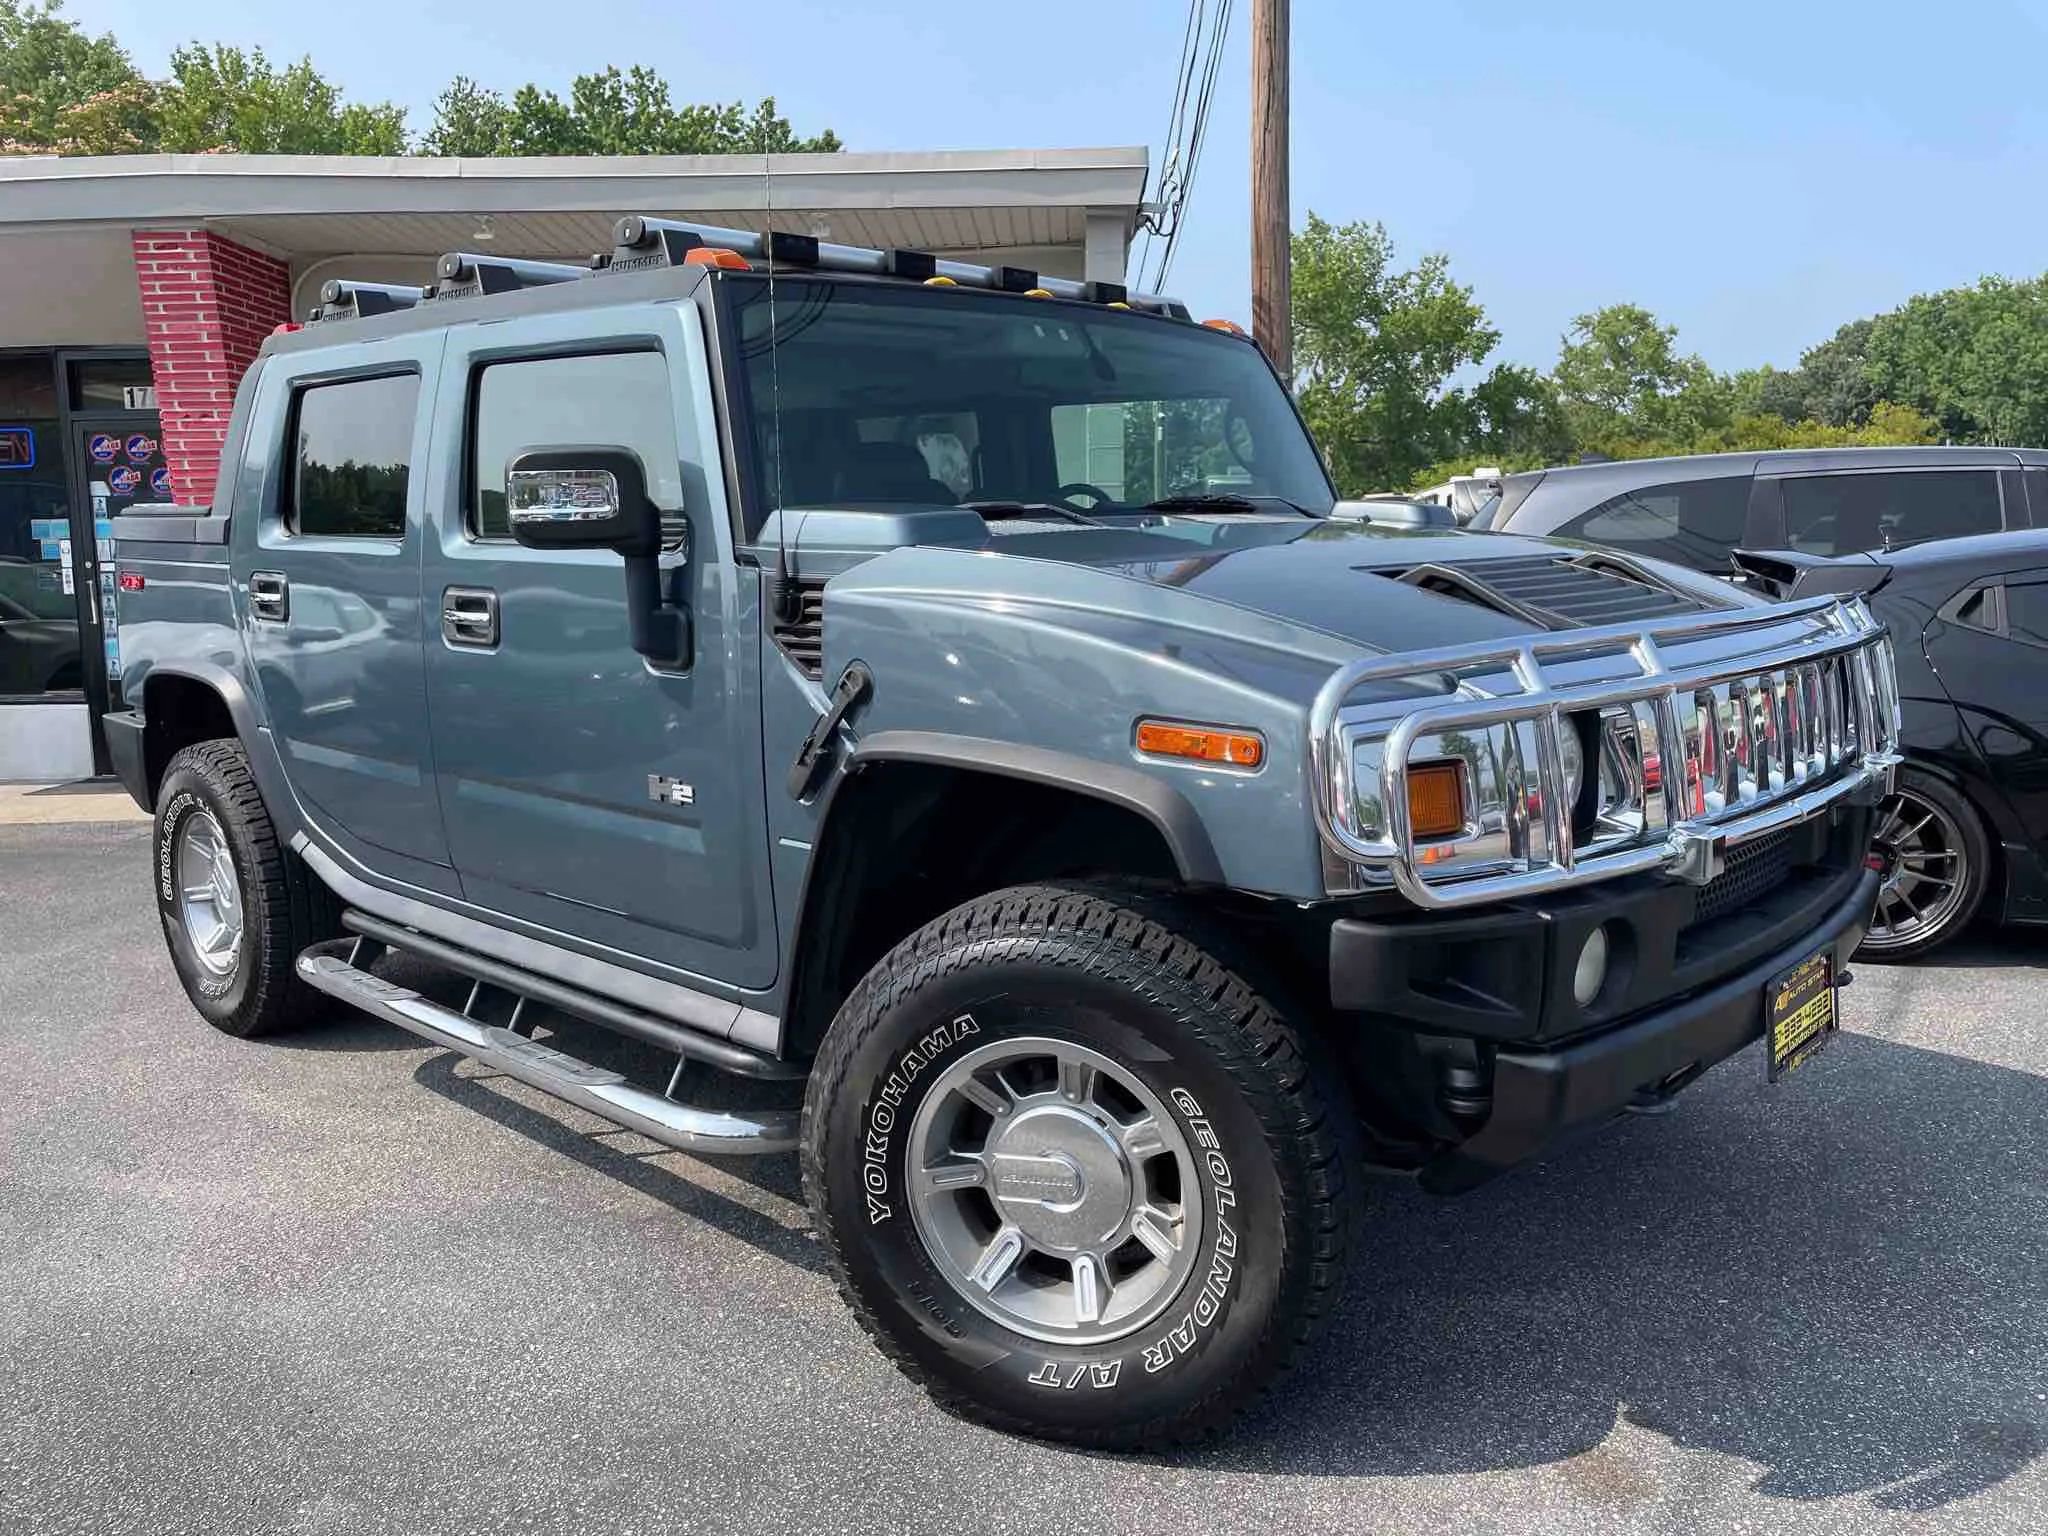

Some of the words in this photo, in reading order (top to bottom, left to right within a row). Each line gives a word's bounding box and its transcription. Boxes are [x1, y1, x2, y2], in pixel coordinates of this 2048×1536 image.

[647, 774, 693, 804] H2
[863, 1013, 980, 1224] YOKOHAMA
[1143, 1086, 1237, 1374] GEOLANDAR
[1027, 1359, 1124, 1391] A/T
